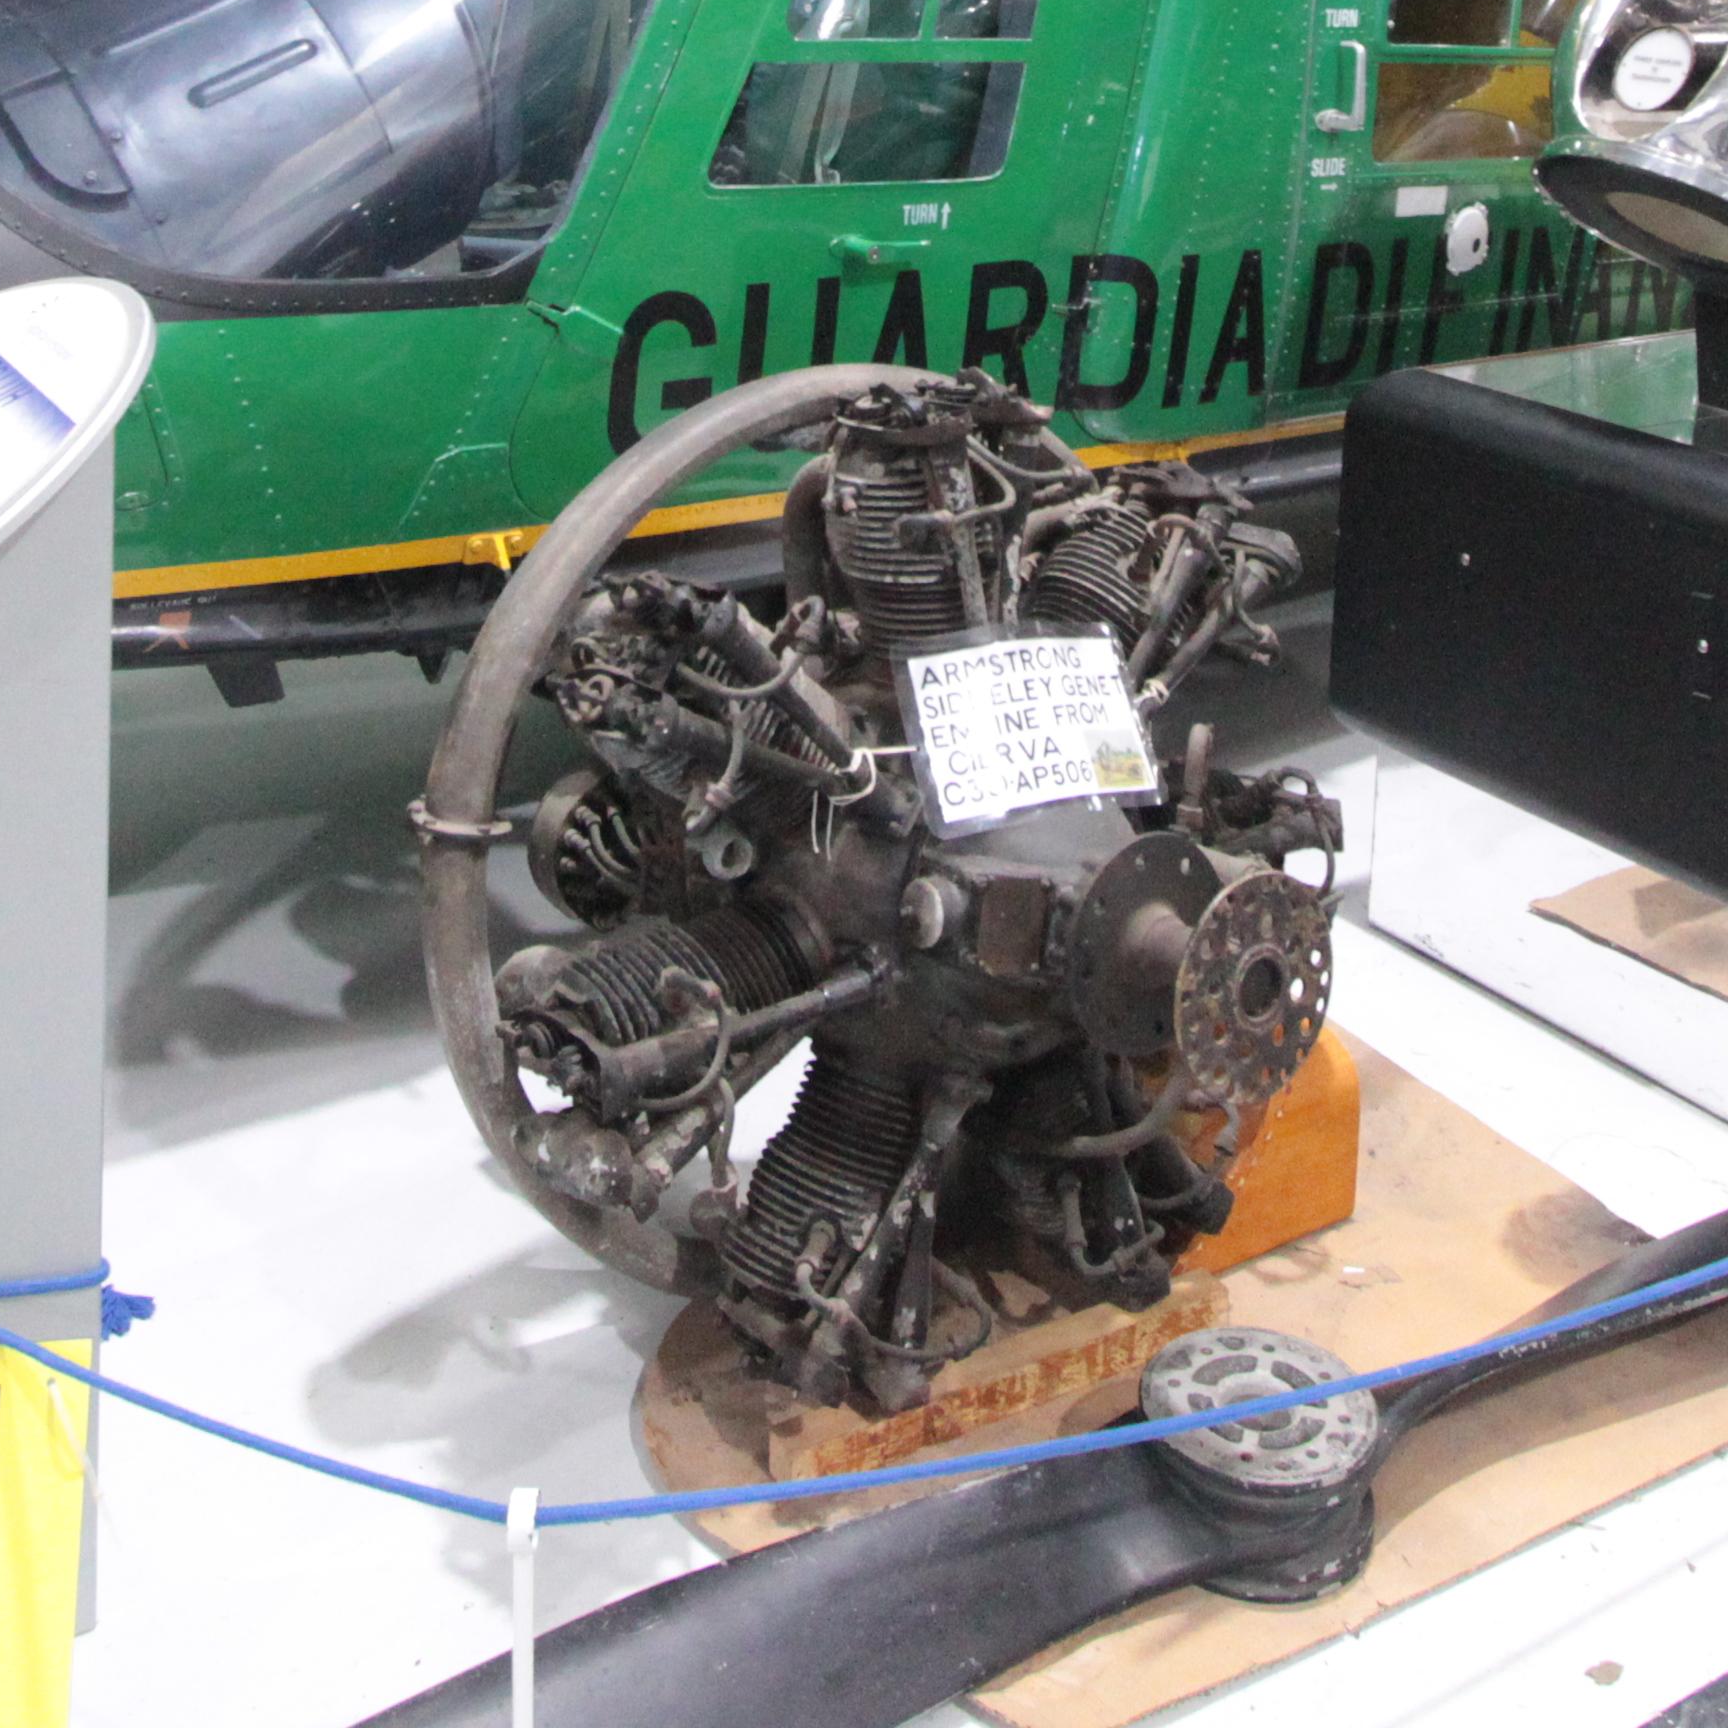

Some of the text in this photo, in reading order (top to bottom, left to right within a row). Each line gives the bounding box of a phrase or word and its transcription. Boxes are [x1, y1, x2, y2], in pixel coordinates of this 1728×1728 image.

[1325, 9, 1360, 28] TURN
[1311, 158, 1347, 177] SLIDE
[903, 203, 939, 227] TURN
[607, 248, 1266, 456] GUARDIA
[1299, 234, 1410, 389] DI
[919, 645, 1083, 692] ARMSTRONG
[1060, 673, 1124, 699] GENET
[929, 701, 1111, 749] ENINE FROM
